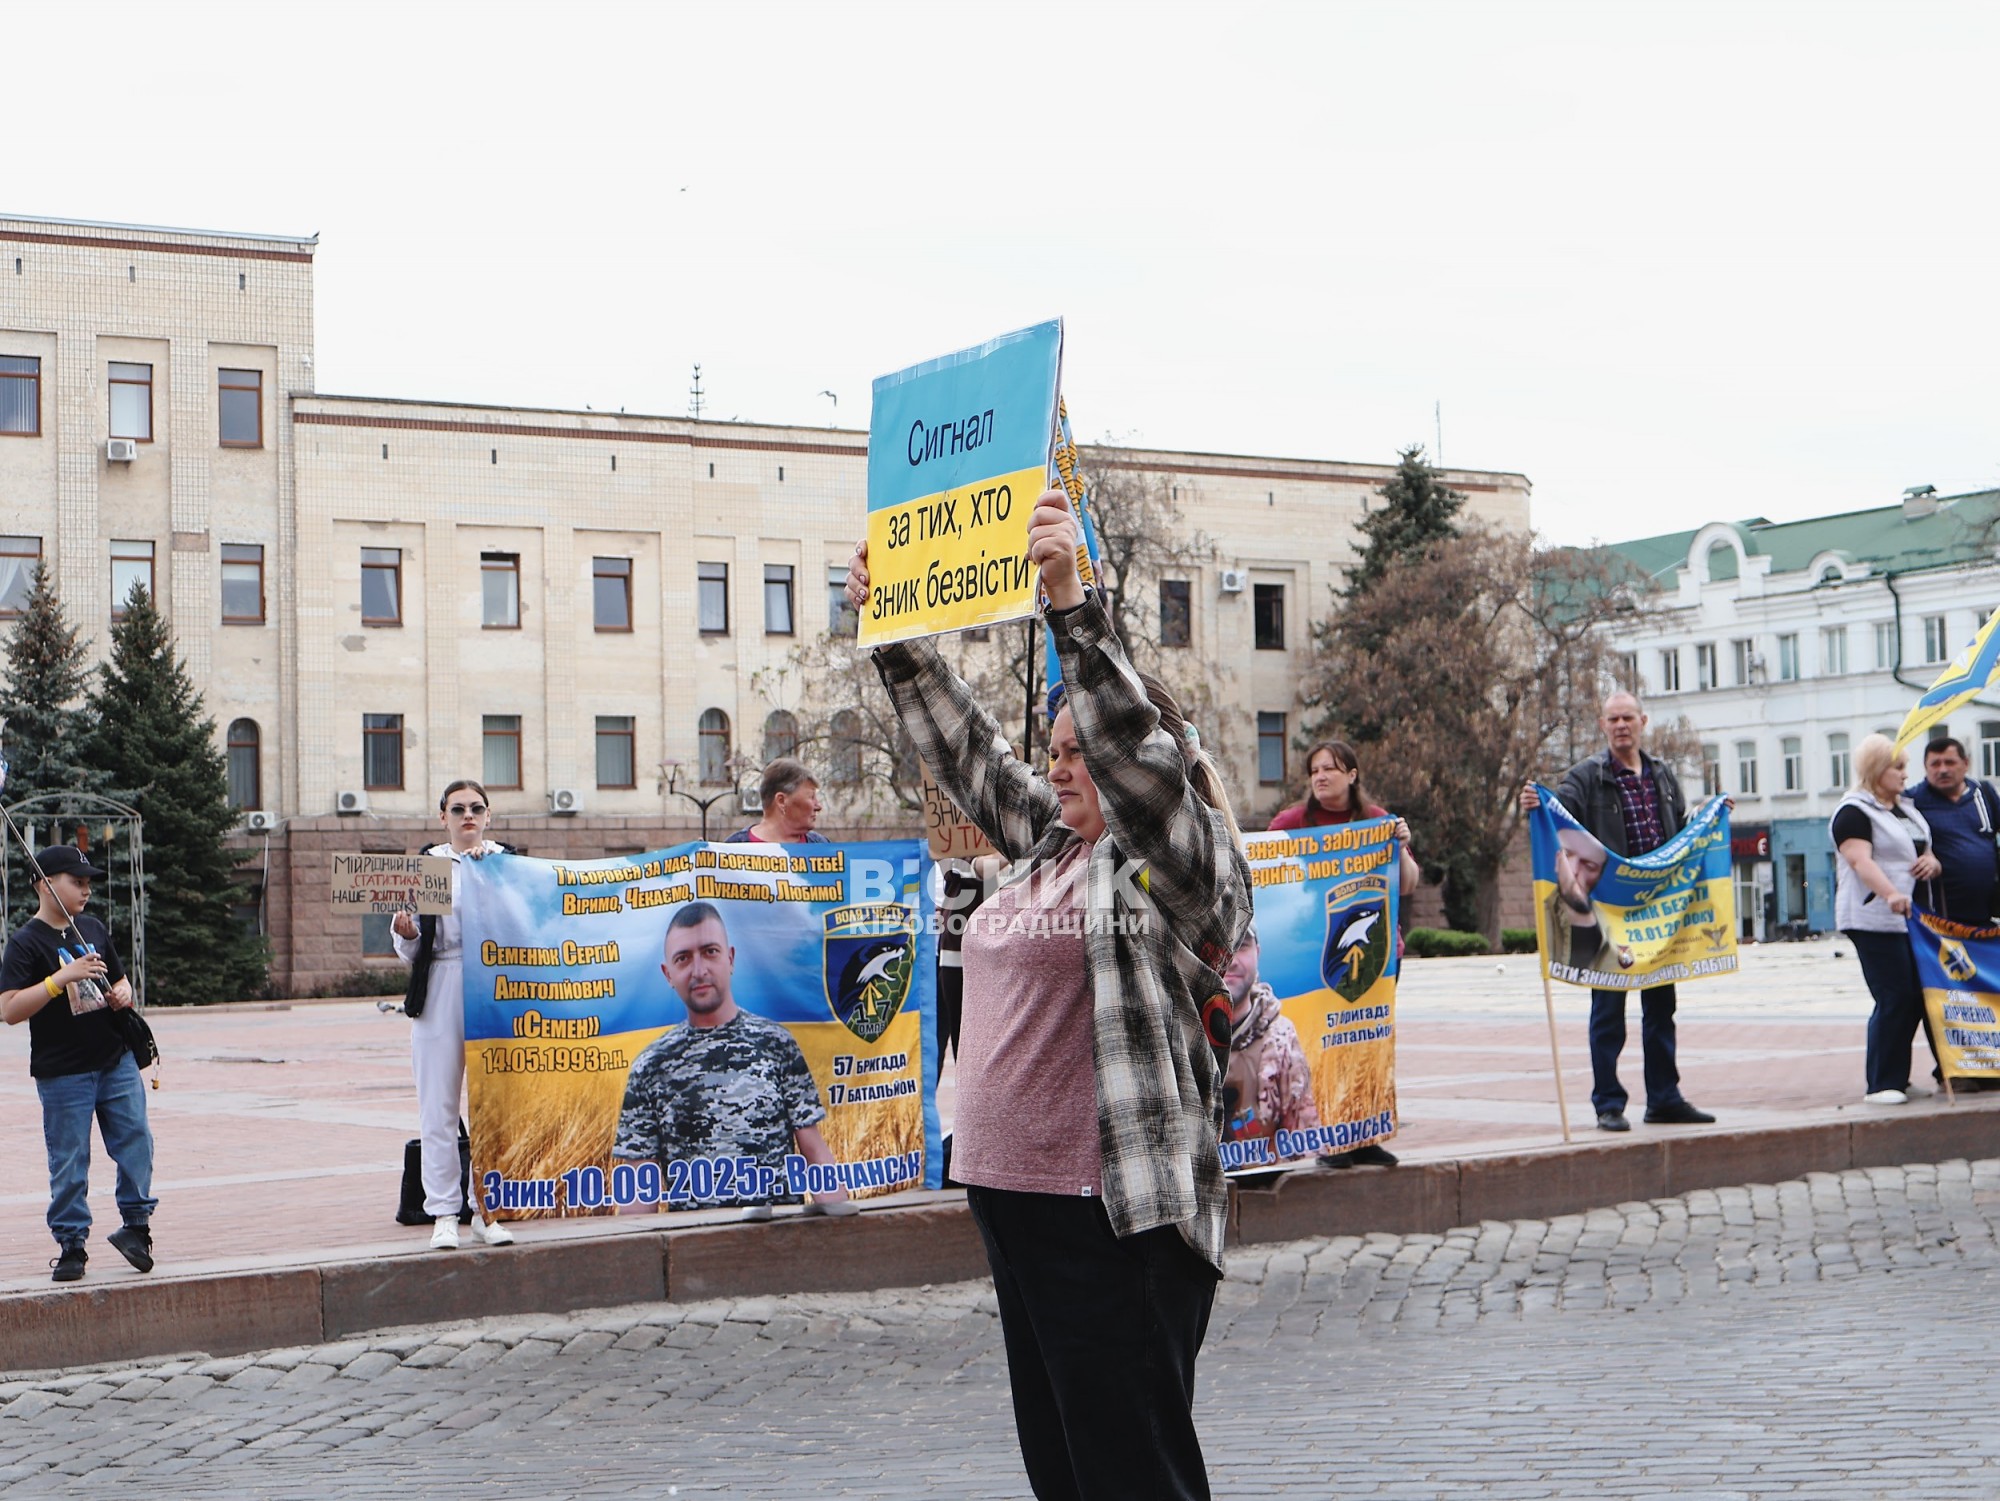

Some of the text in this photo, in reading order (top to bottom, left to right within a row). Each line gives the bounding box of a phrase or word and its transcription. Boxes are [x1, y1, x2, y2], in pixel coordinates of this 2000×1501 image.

[908, 409, 994, 466] Сигнал
[888, 484, 1012, 549] за тих, хто
[872, 549, 1030, 620] зник безвісти
[928, 801, 972, 828] ЗНИ
[1246, 836, 1319, 860] значить
[406, 858, 423, 872] НЕ
[1252, 862, 1305, 888] ерніть
[1308, 859, 1340, 880] моє
[332, 889, 366, 904] НАШЕ
[835, 908, 863, 925] ВОЛЯ
[872, 907, 904, 920] ЧЕСТЬ
[834, 1055, 854, 1076] 57
[828, 1084, 845, 1104] 17
